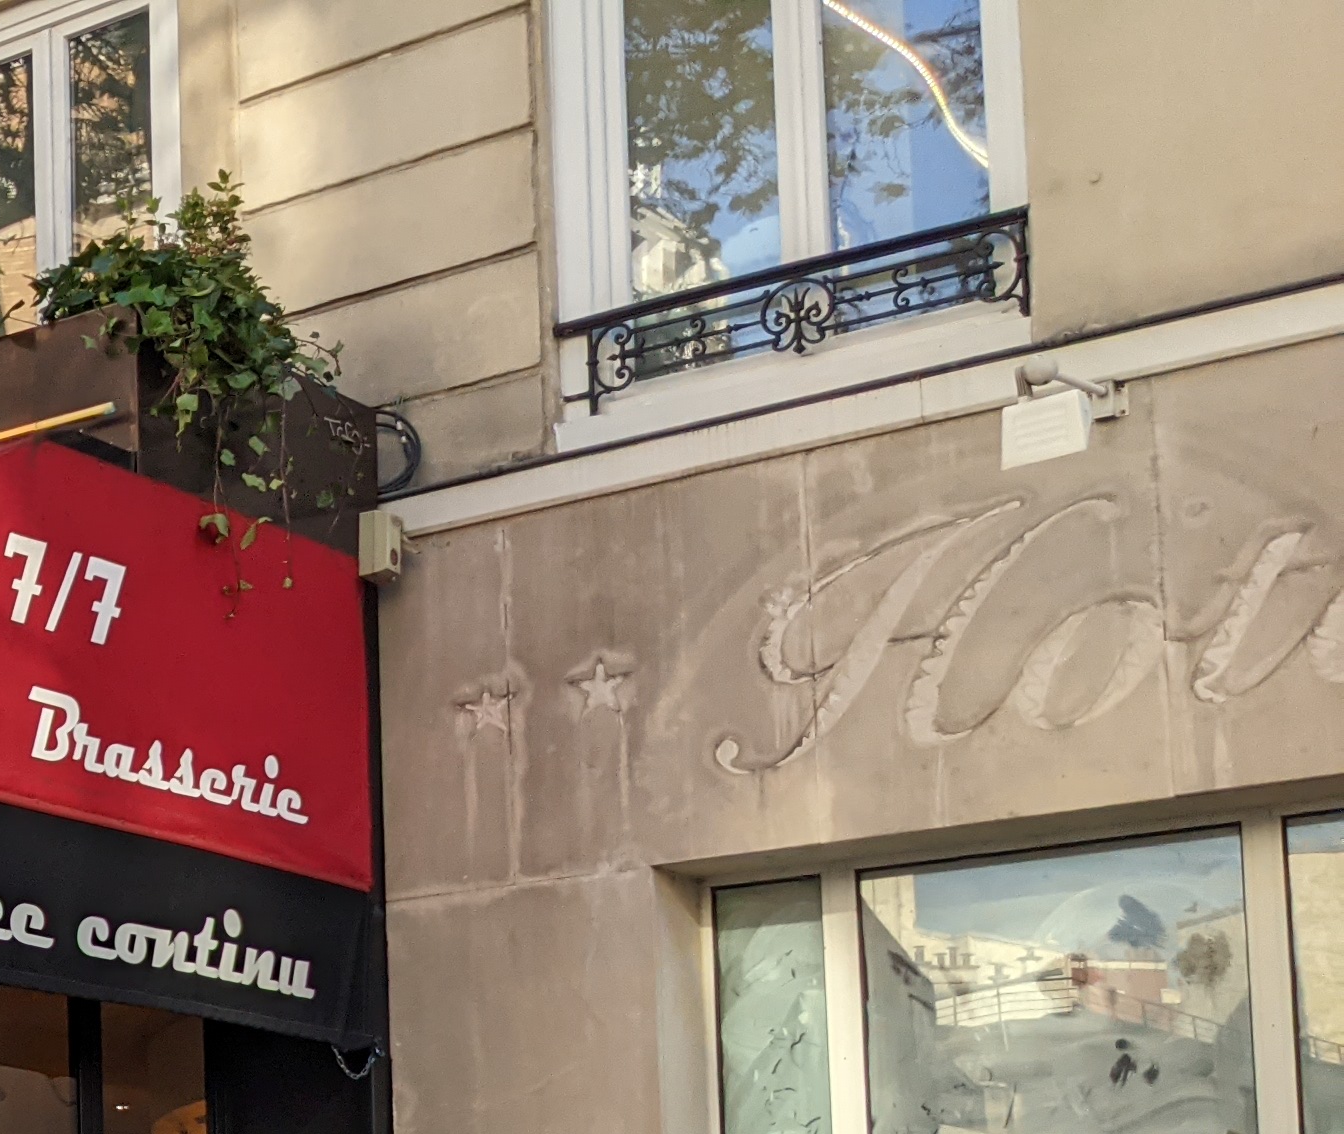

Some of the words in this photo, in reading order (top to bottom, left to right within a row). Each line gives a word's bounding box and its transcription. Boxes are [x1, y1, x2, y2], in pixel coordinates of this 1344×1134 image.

[4, 531, 126, 646] 7/7
[27, 685, 309, 825] Brasserie
[76, 908, 315, 1000] continu
